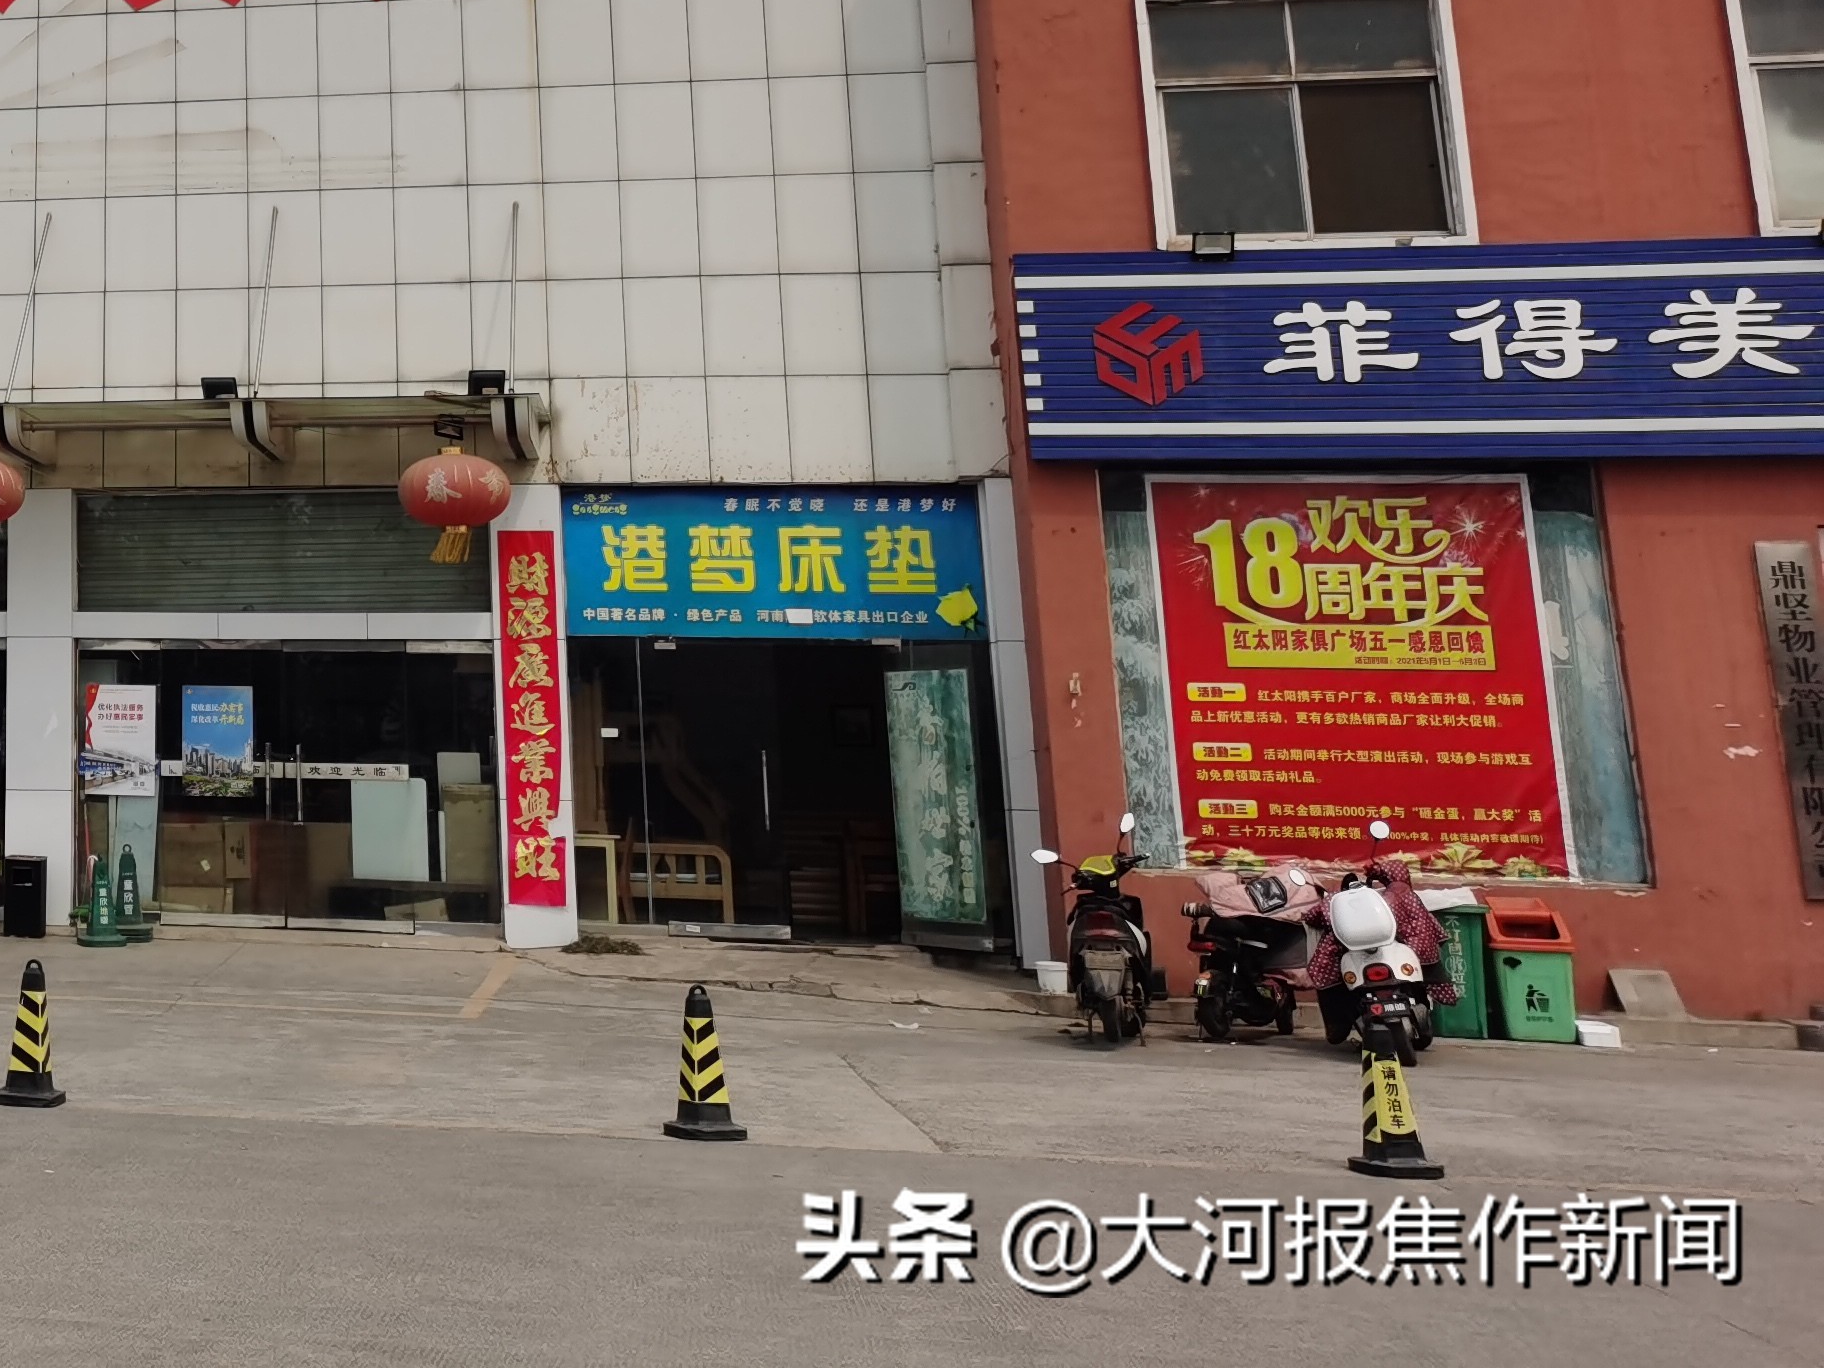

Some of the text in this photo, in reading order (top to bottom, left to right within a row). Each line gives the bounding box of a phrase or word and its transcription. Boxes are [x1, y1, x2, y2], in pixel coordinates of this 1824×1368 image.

[1263, 288, 1814, 384] 菲得美
[723, 498, 958, 513] 春眠不觉晓 还是港梦好
[1306, 495, 1452, 564] 欢乐
[601, 524, 939, 594] 港梦床垫
[1193, 517, 1489, 623] 18 周年庆
[582, 607, 666, 622] 中国著名品牌
[686, 608, 743, 623] 绿色产品
[1232, 628, 1486, 654] 红太阳家俱广场五一感恩回馈
[307, 765, 387, 778] 欢迎光临
[1380, 1065, 1406, 1130] 请勿泊车
